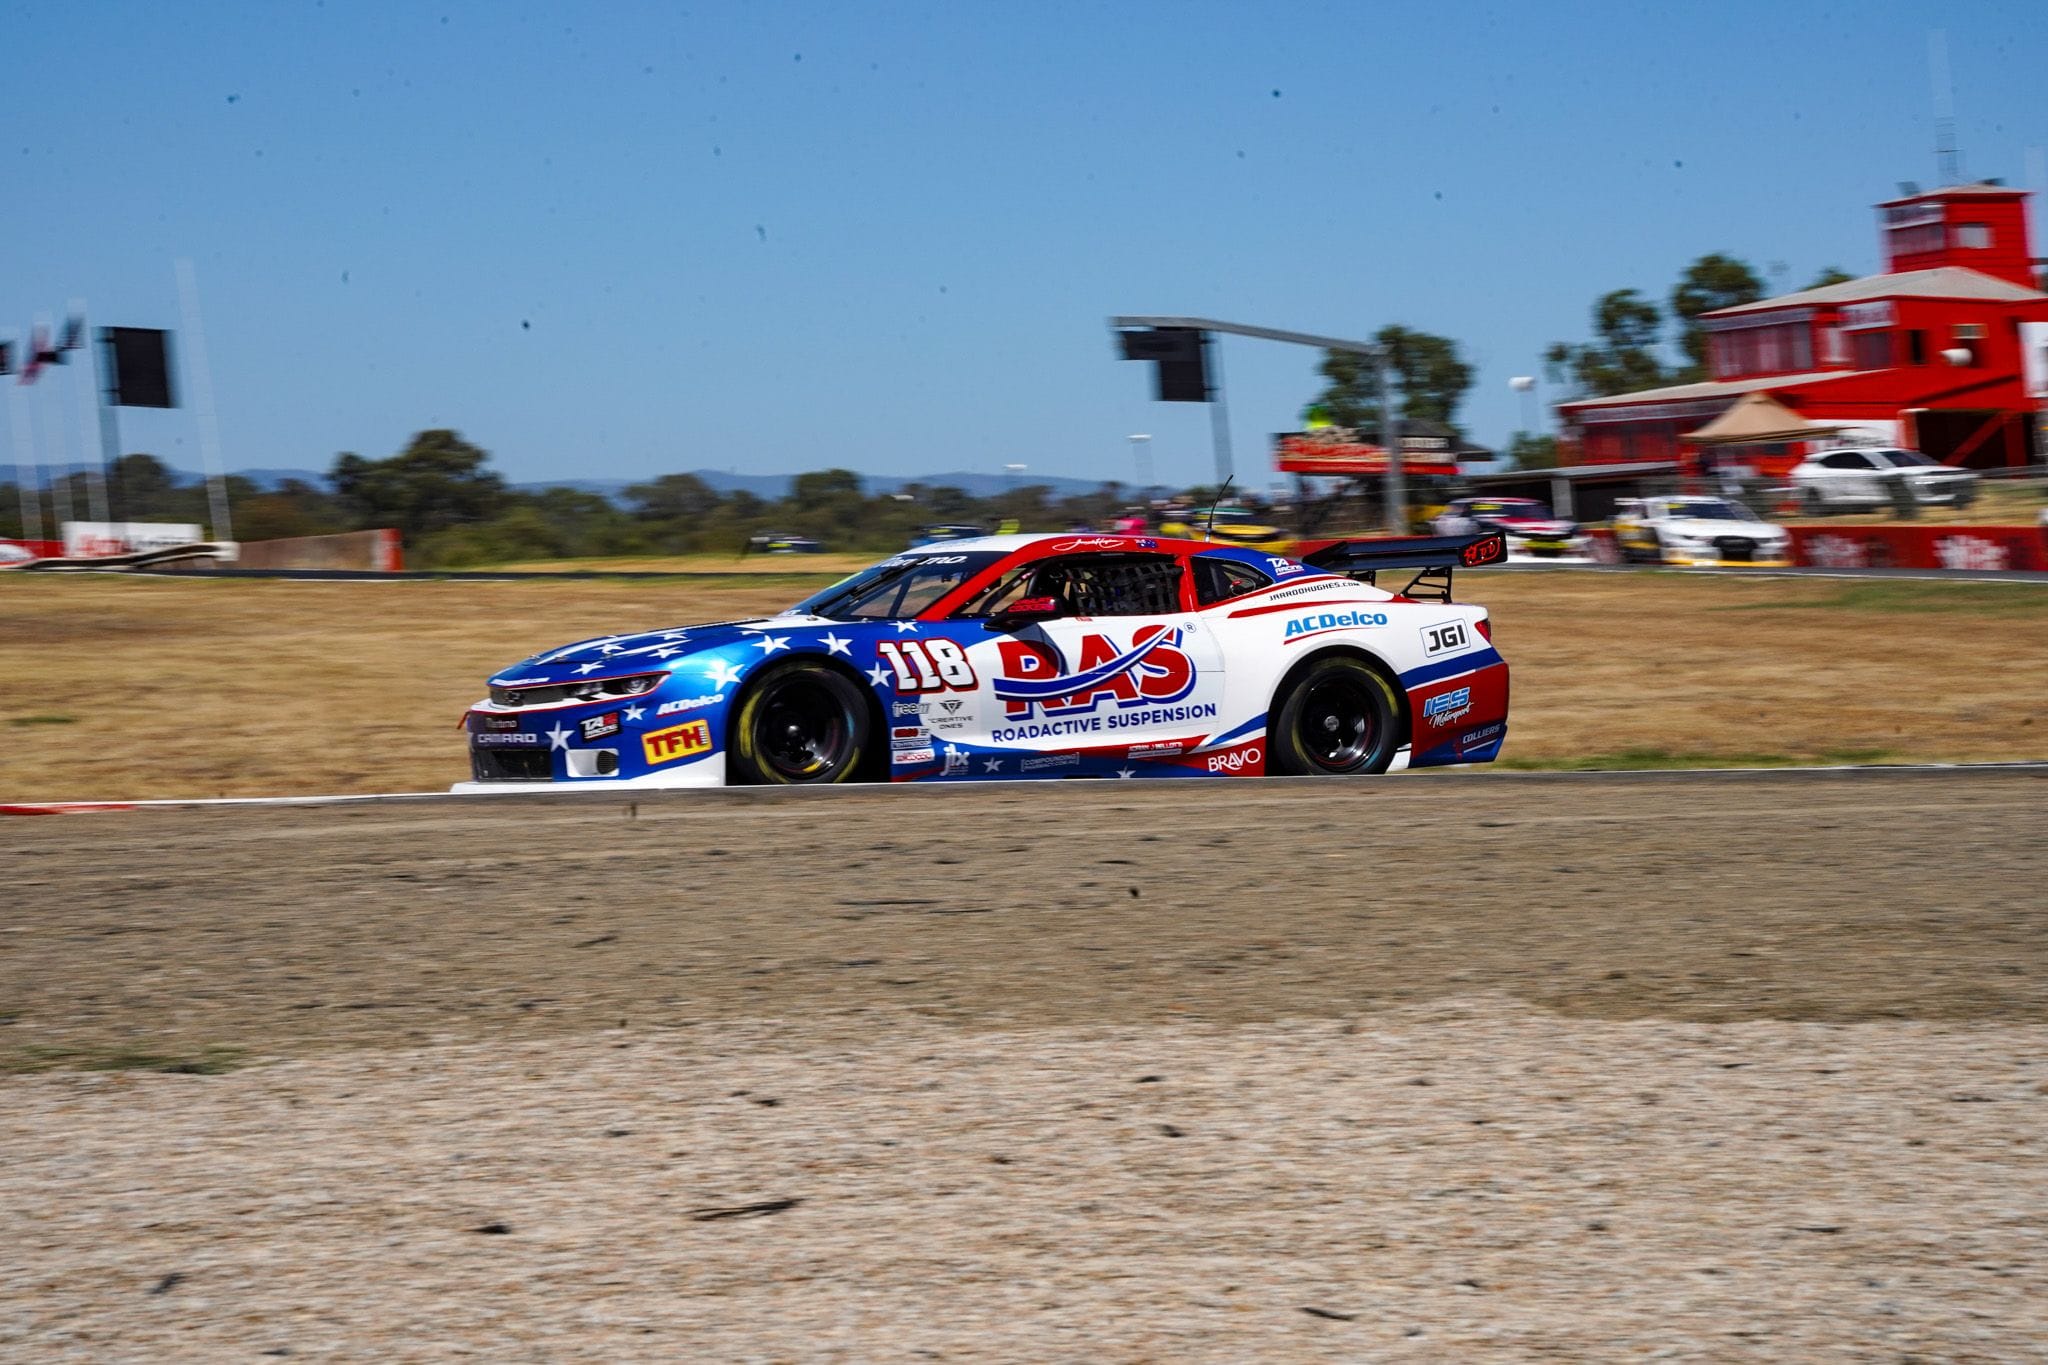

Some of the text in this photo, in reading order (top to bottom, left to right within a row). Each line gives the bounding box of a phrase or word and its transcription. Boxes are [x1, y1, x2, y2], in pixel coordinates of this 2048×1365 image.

[1285, 611, 1388, 637] ACDelco
[1429, 624, 1466, 652] JGI
[876, 637, 979, 696] 118
[993, 624, 1198, 722] RAS
[992, 702, 1217, 743] ROADACTIVE SUSPENSION
[1429, 702, 1475, 728] Motorsport
[646, 725, 703, 757] TFH
[1462, 723, 1501, 744] COLLIERS
[1207, 748, 1261, 772] BRAVO
